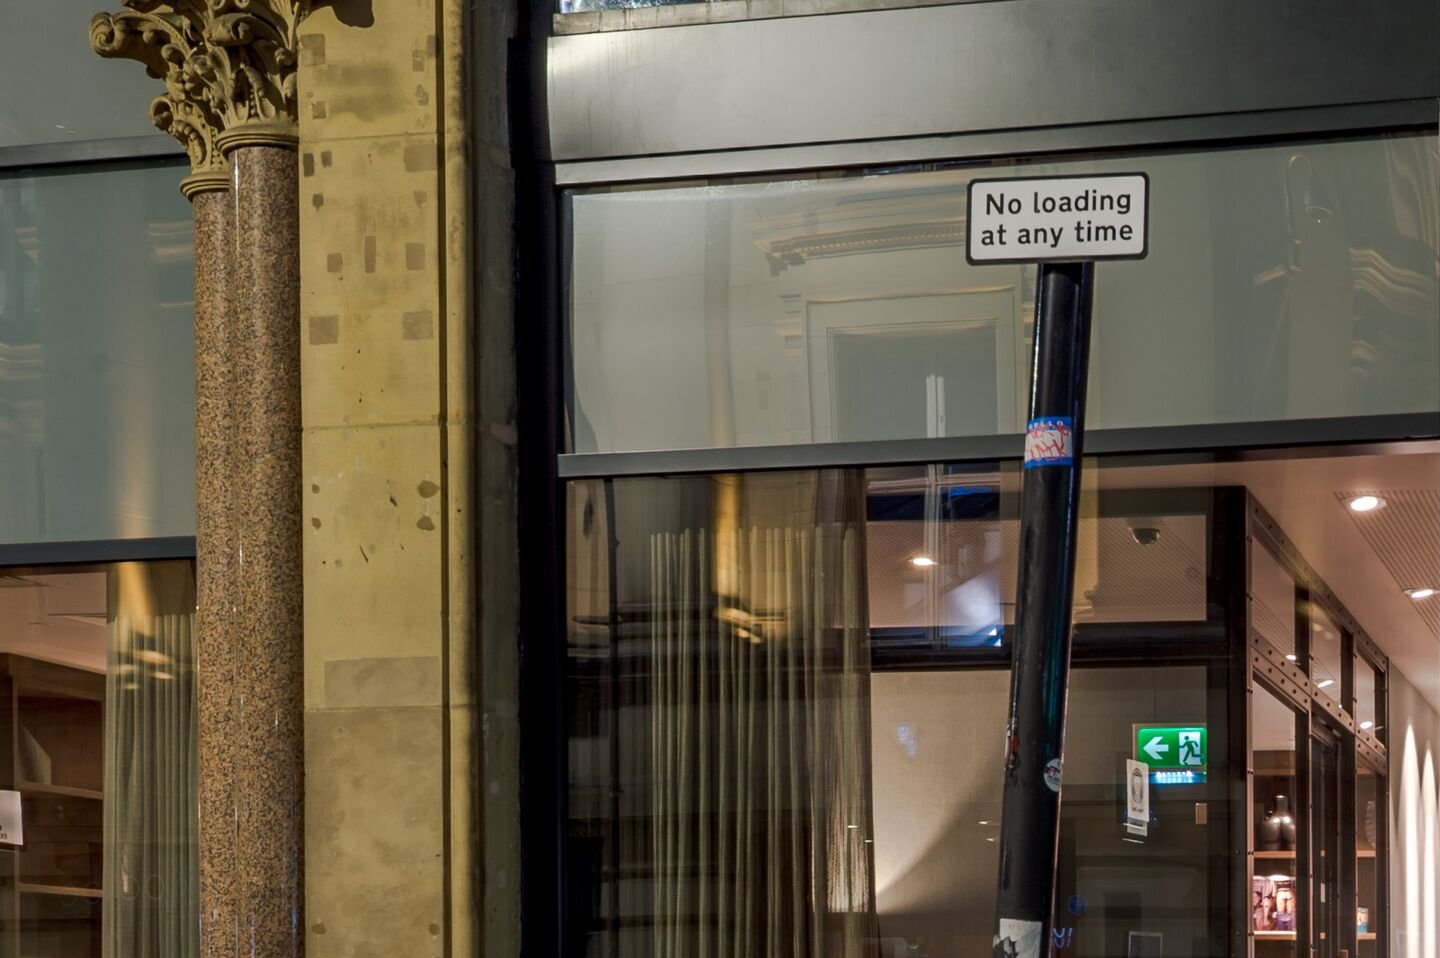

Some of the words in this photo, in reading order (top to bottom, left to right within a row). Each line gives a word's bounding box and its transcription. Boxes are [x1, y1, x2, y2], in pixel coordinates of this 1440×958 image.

[986, 193, 1022, 215] No
[1033, 189, 1131, 214] loading
[981, 223, 1007, 246] at
[1017, 226, 1064, 248] any
[1074, 220, 1133, 243] time
